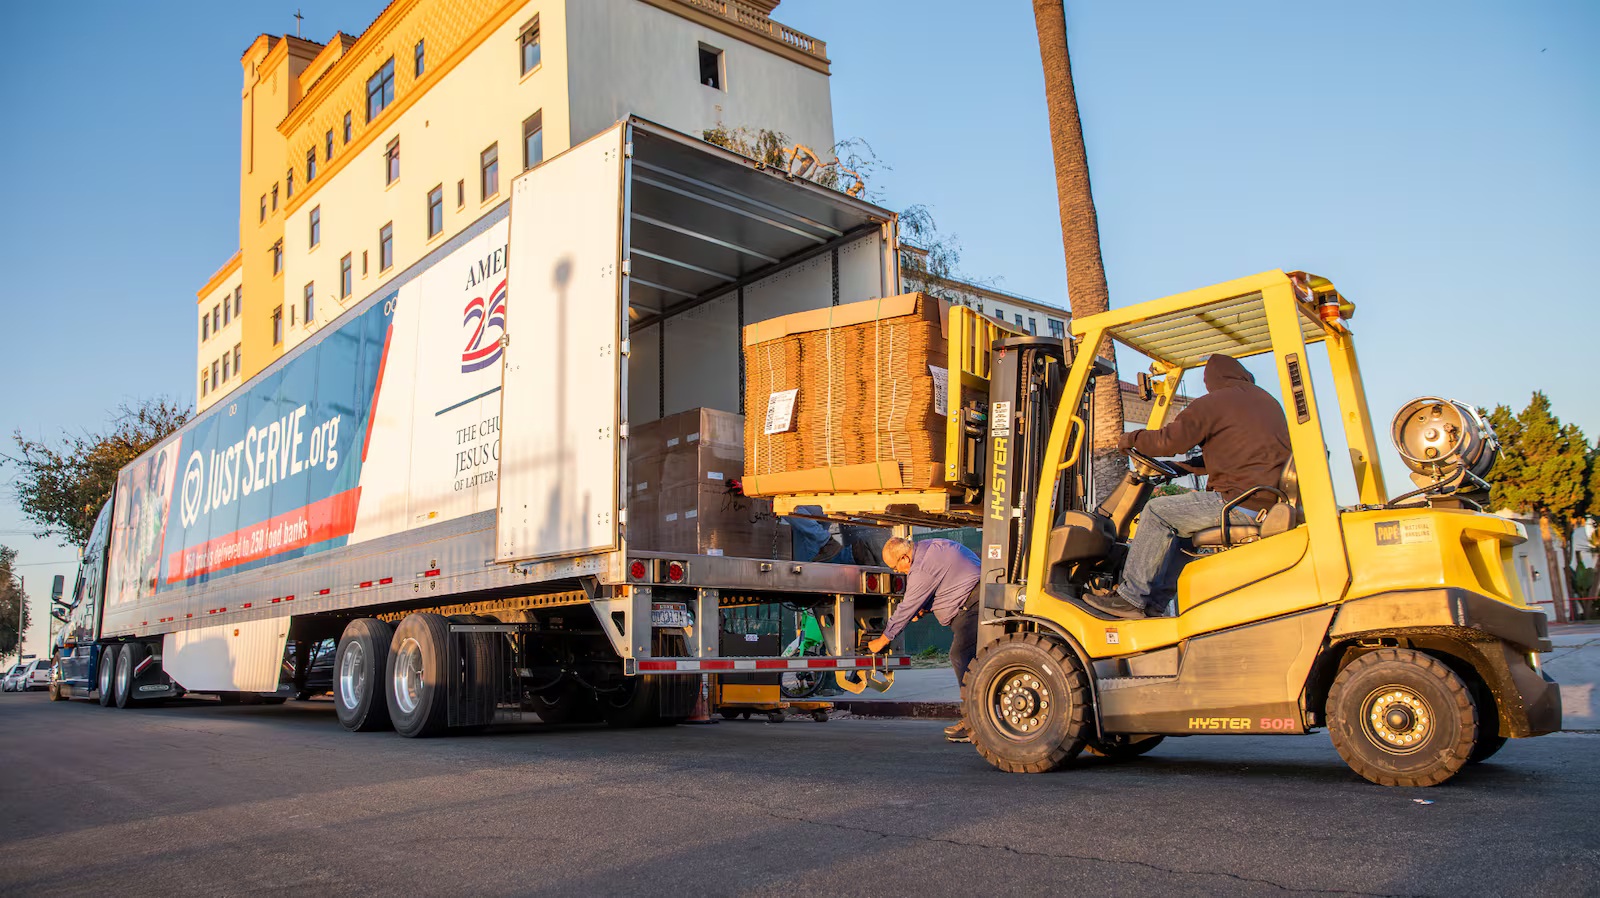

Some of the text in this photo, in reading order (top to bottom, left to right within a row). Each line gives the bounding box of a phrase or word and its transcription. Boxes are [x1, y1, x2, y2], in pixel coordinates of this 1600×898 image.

[456, 424, 477, 445] THE
[455, 443, 489, 478] JESUS
[454, 479, 465, 492] OF
[990, 437, 1008, 520] HYSTER
[214, 537, 241, 564] delivered
[242, 536, 250, 557] to
[250, 529, 265, 553] 250
[284, 516, 308, 545] banks
[1188, 717, 1252, 730] HYSTER
